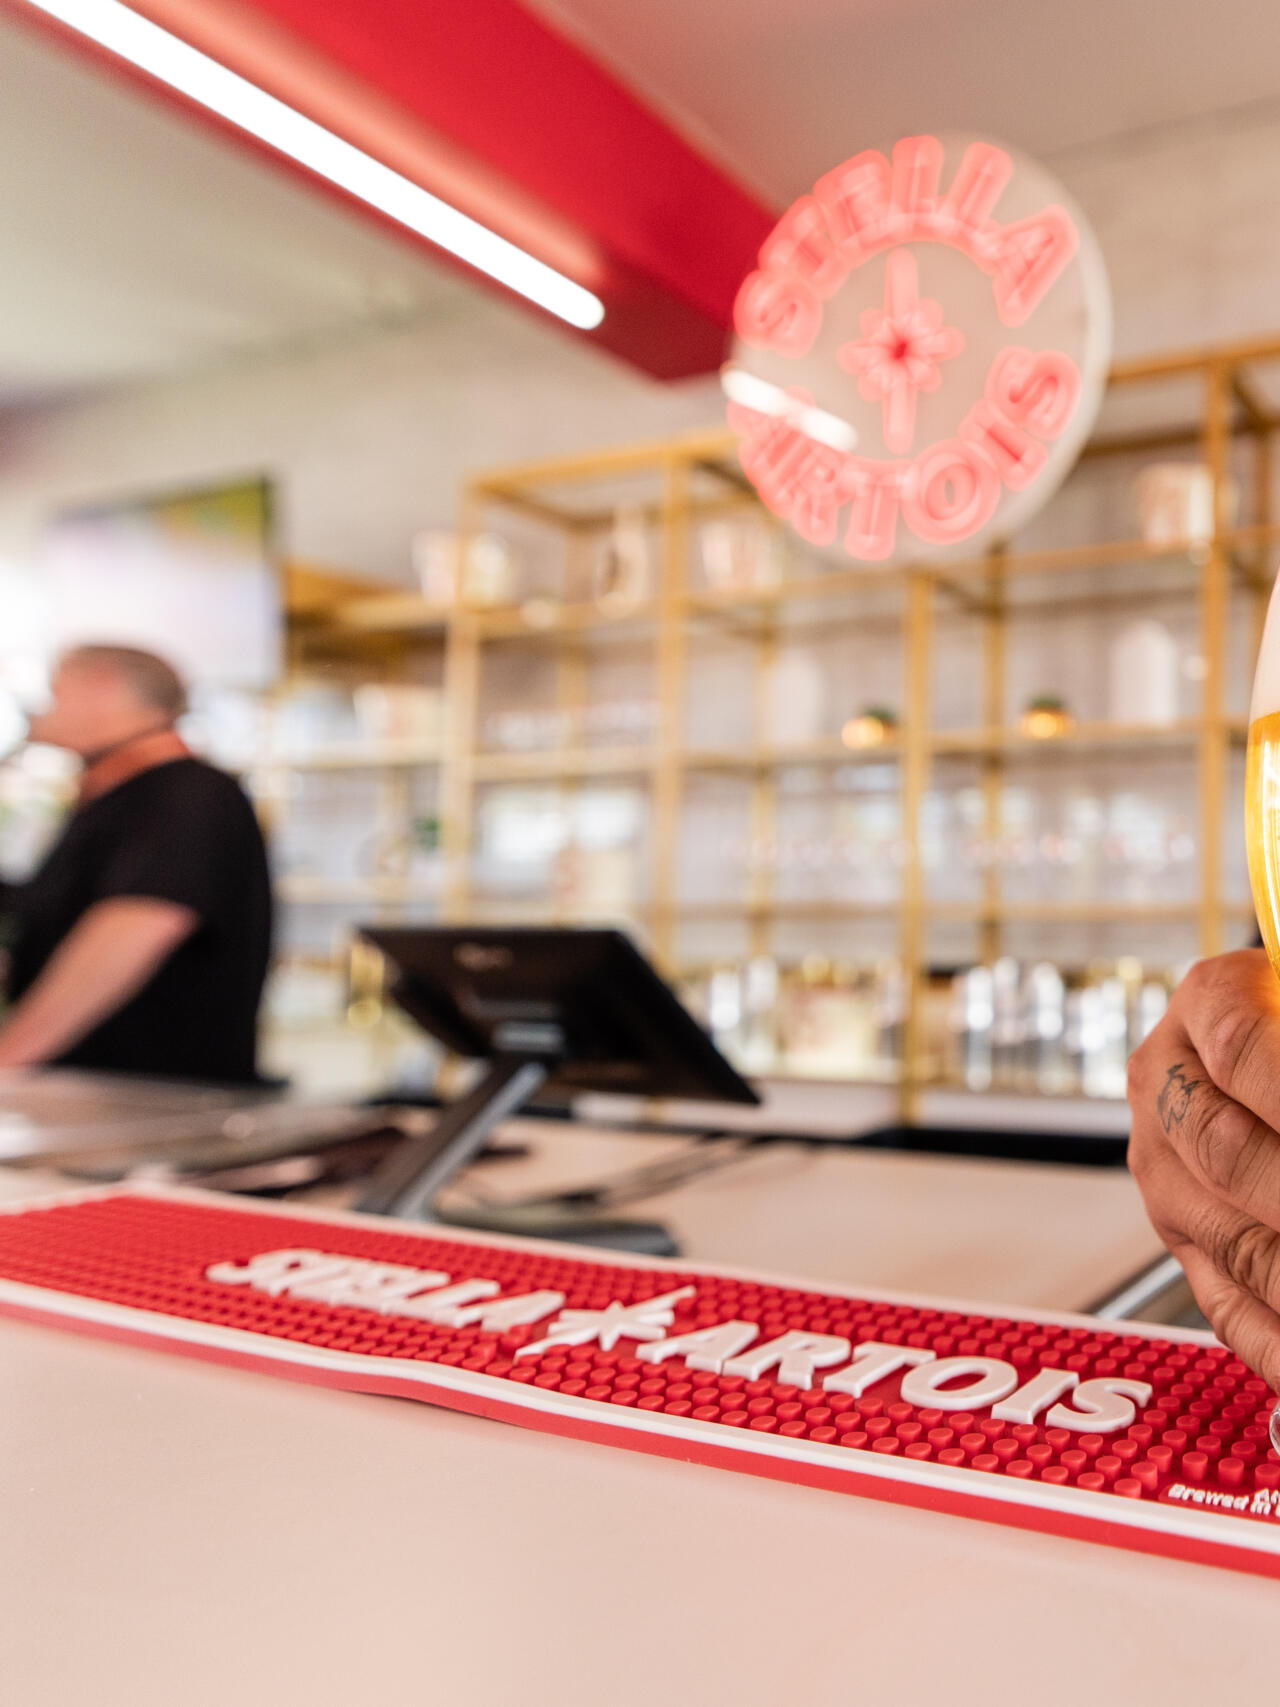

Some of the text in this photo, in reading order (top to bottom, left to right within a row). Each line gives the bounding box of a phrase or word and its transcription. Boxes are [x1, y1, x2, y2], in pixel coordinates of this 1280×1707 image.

[733, 135, 1080, 358] STELLA
[727, 346, 1082, 561] ARTOIS
[205, 1247, 1153, 1433] STELLA ARTOIS
[1168, 1482, 1249, 1510] Brewed
[1250, 1497, 1271, 1515] in
